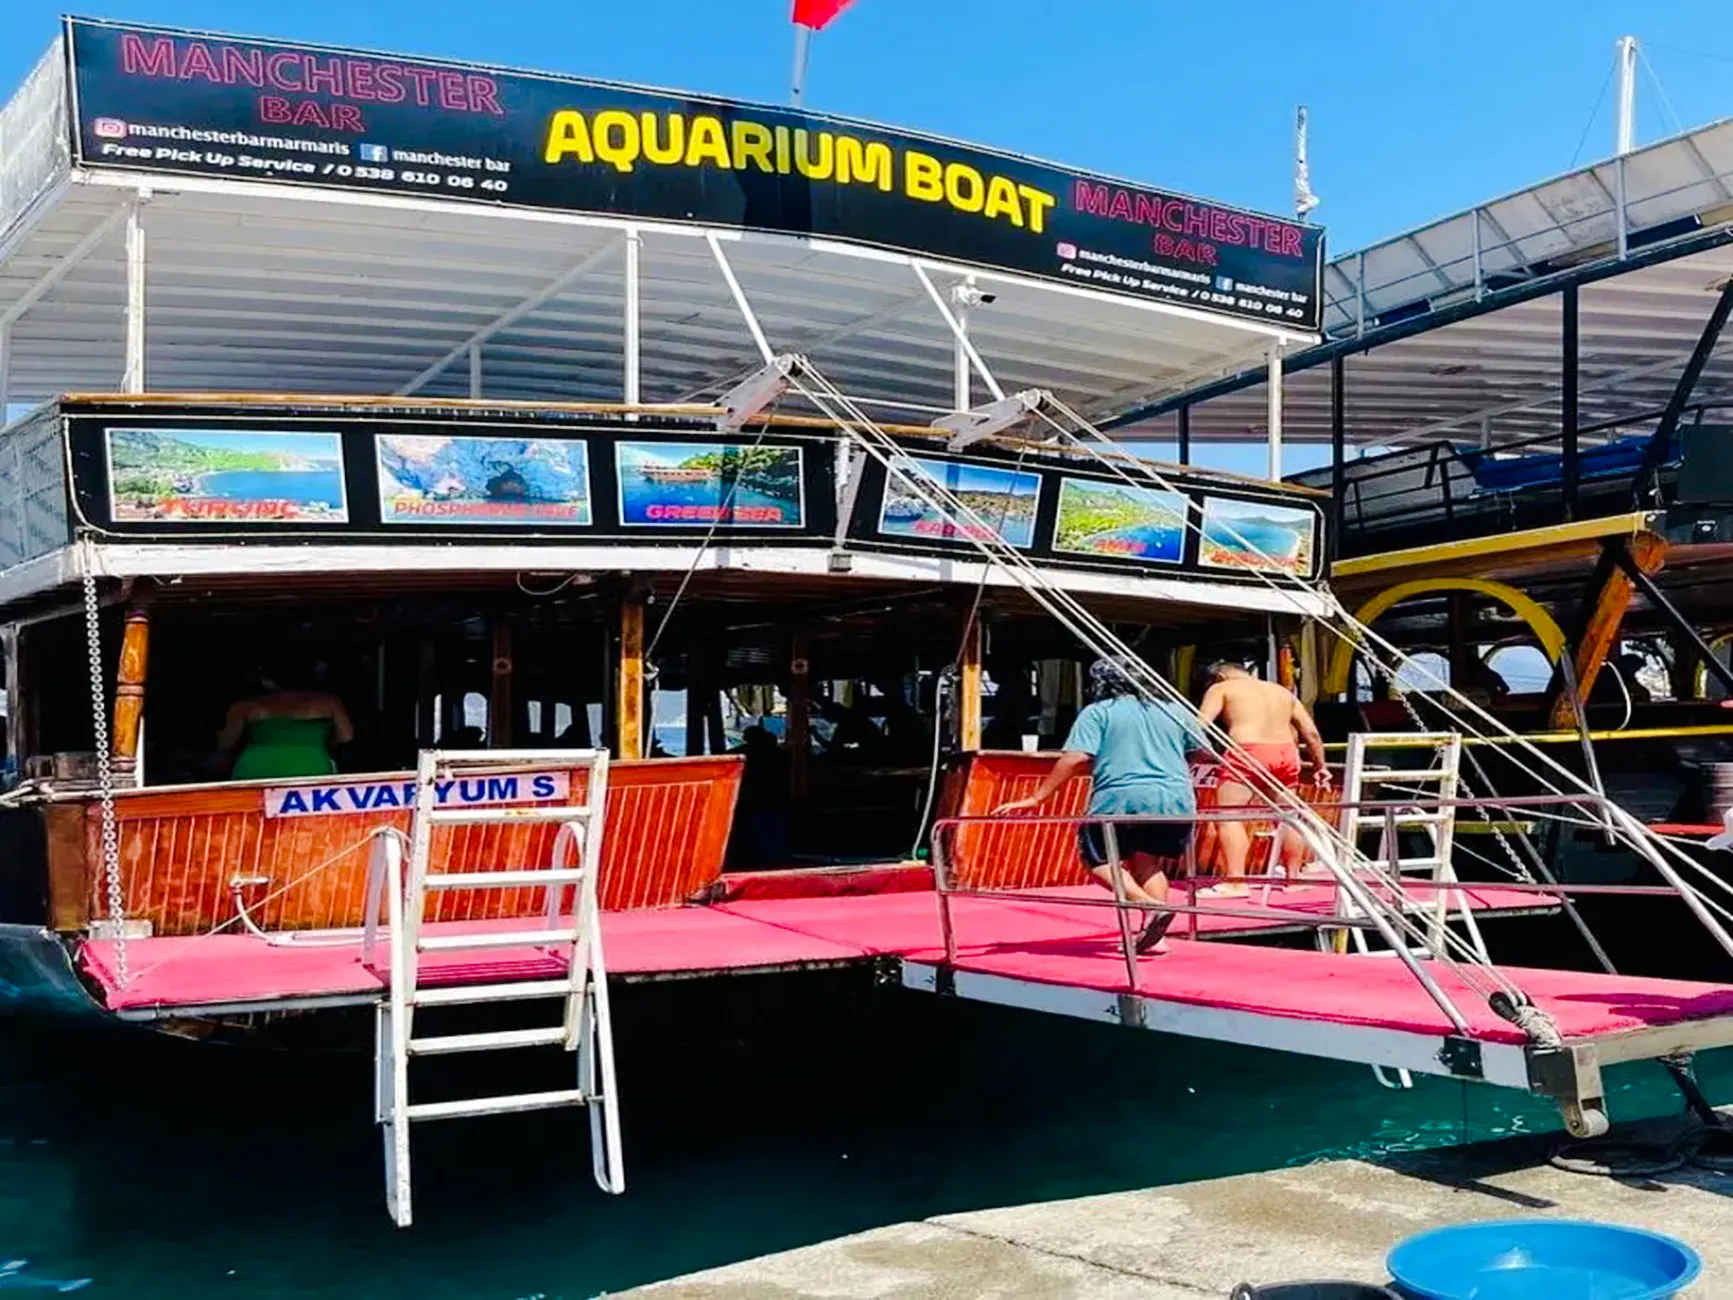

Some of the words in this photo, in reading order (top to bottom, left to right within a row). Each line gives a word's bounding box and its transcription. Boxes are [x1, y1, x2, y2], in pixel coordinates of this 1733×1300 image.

[121, 33, 504, 114] MANCHESTER
[260, 95, 365, 132] BAR
[102, 143, 153, 158] Free
[156, 147, 201, 163] Pick
[206, 152, 235, 167] Up
[238, 155, 315, 174] Service
[355, 166, 395, 180] 538
[401, 170, 441, 184] 610
[447, 175, 474, 188] 06
[480, 179, 509, 192] 40
[128, 123, 350, 155] manchesterbarmarmaris
[392, 149, 482, 170] manchester
[485, 158, 511, 173] bar
[545, 109, 893, 192] AQUARIUM
[905, 150, 1056, 234] BOAT
[1074, 180, 1303, 257] MANCHESTER
[1154, 232, 1219, 266] BAR
[1061, 262, 1092, 277] Free
[1093, 268, 1121, 283] Pick
[1123, 275, 1142, 289] Up
[1143, 279, 1189, 297] Service
[532, 775, 555, 798] S
